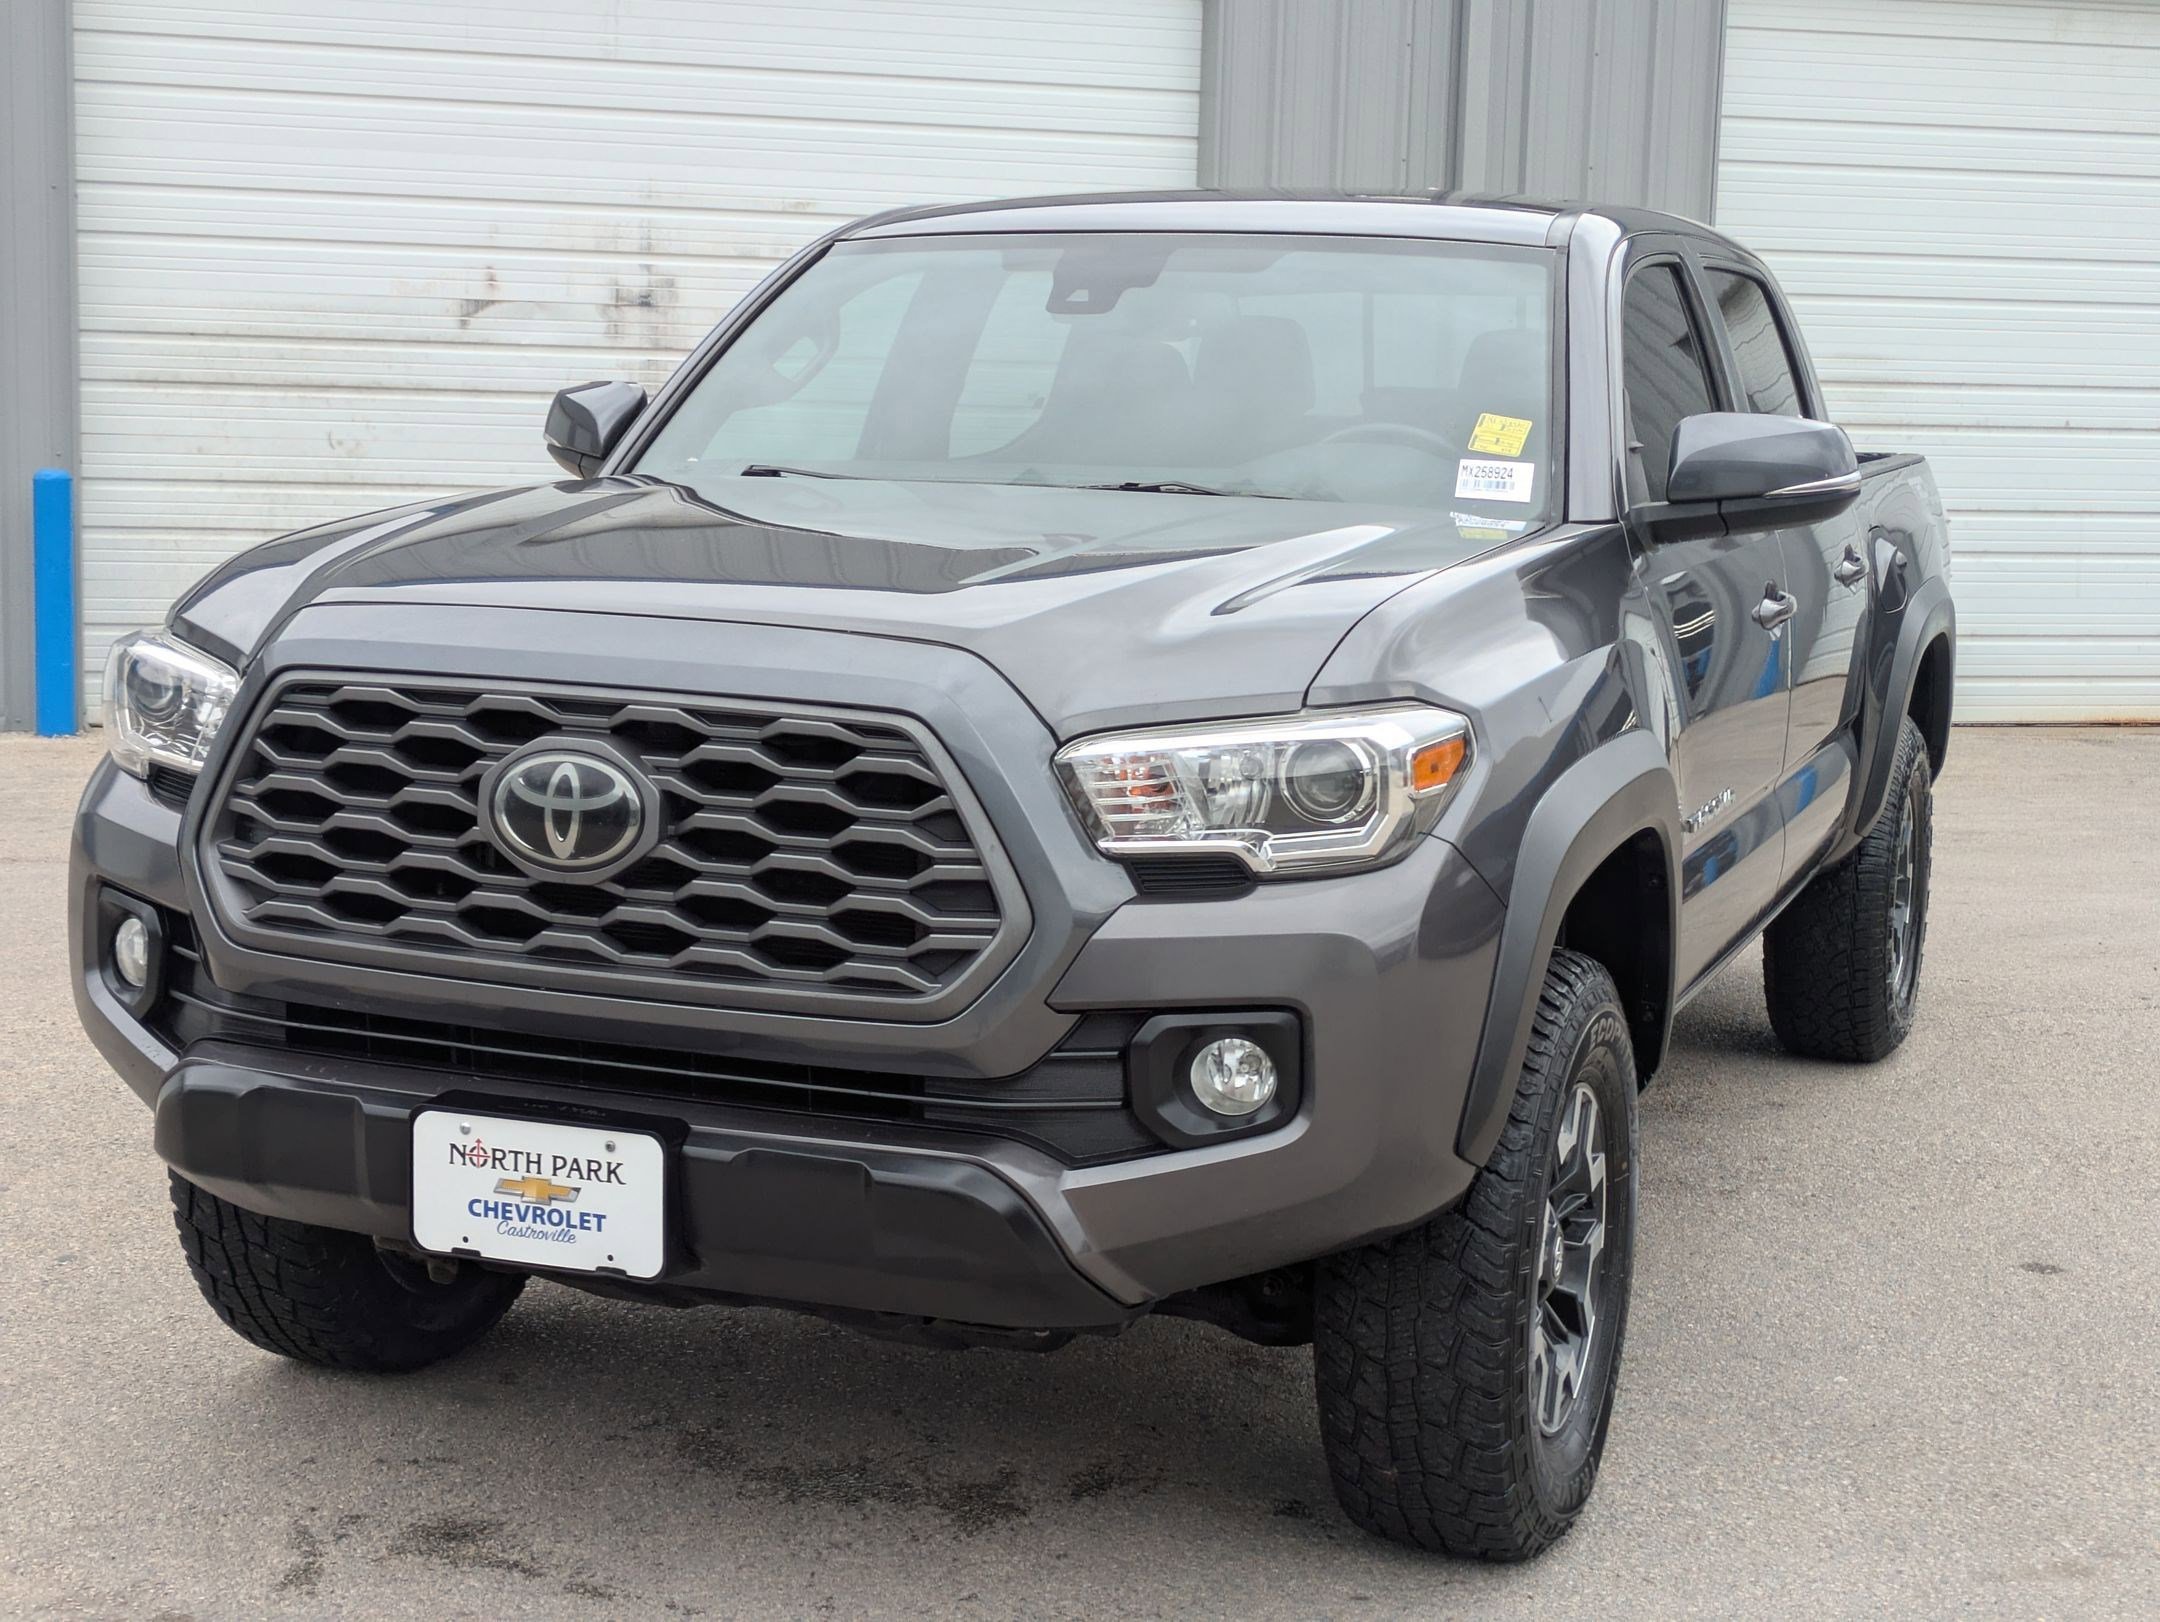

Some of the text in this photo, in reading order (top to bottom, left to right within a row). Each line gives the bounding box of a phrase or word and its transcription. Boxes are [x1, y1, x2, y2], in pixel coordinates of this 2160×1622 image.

[449, 1142, 627, 1185] NORTH PARK
[467, 1198, 607, 1233] CHEVROLET
[496, 1220, 577, 1245] Castroville
